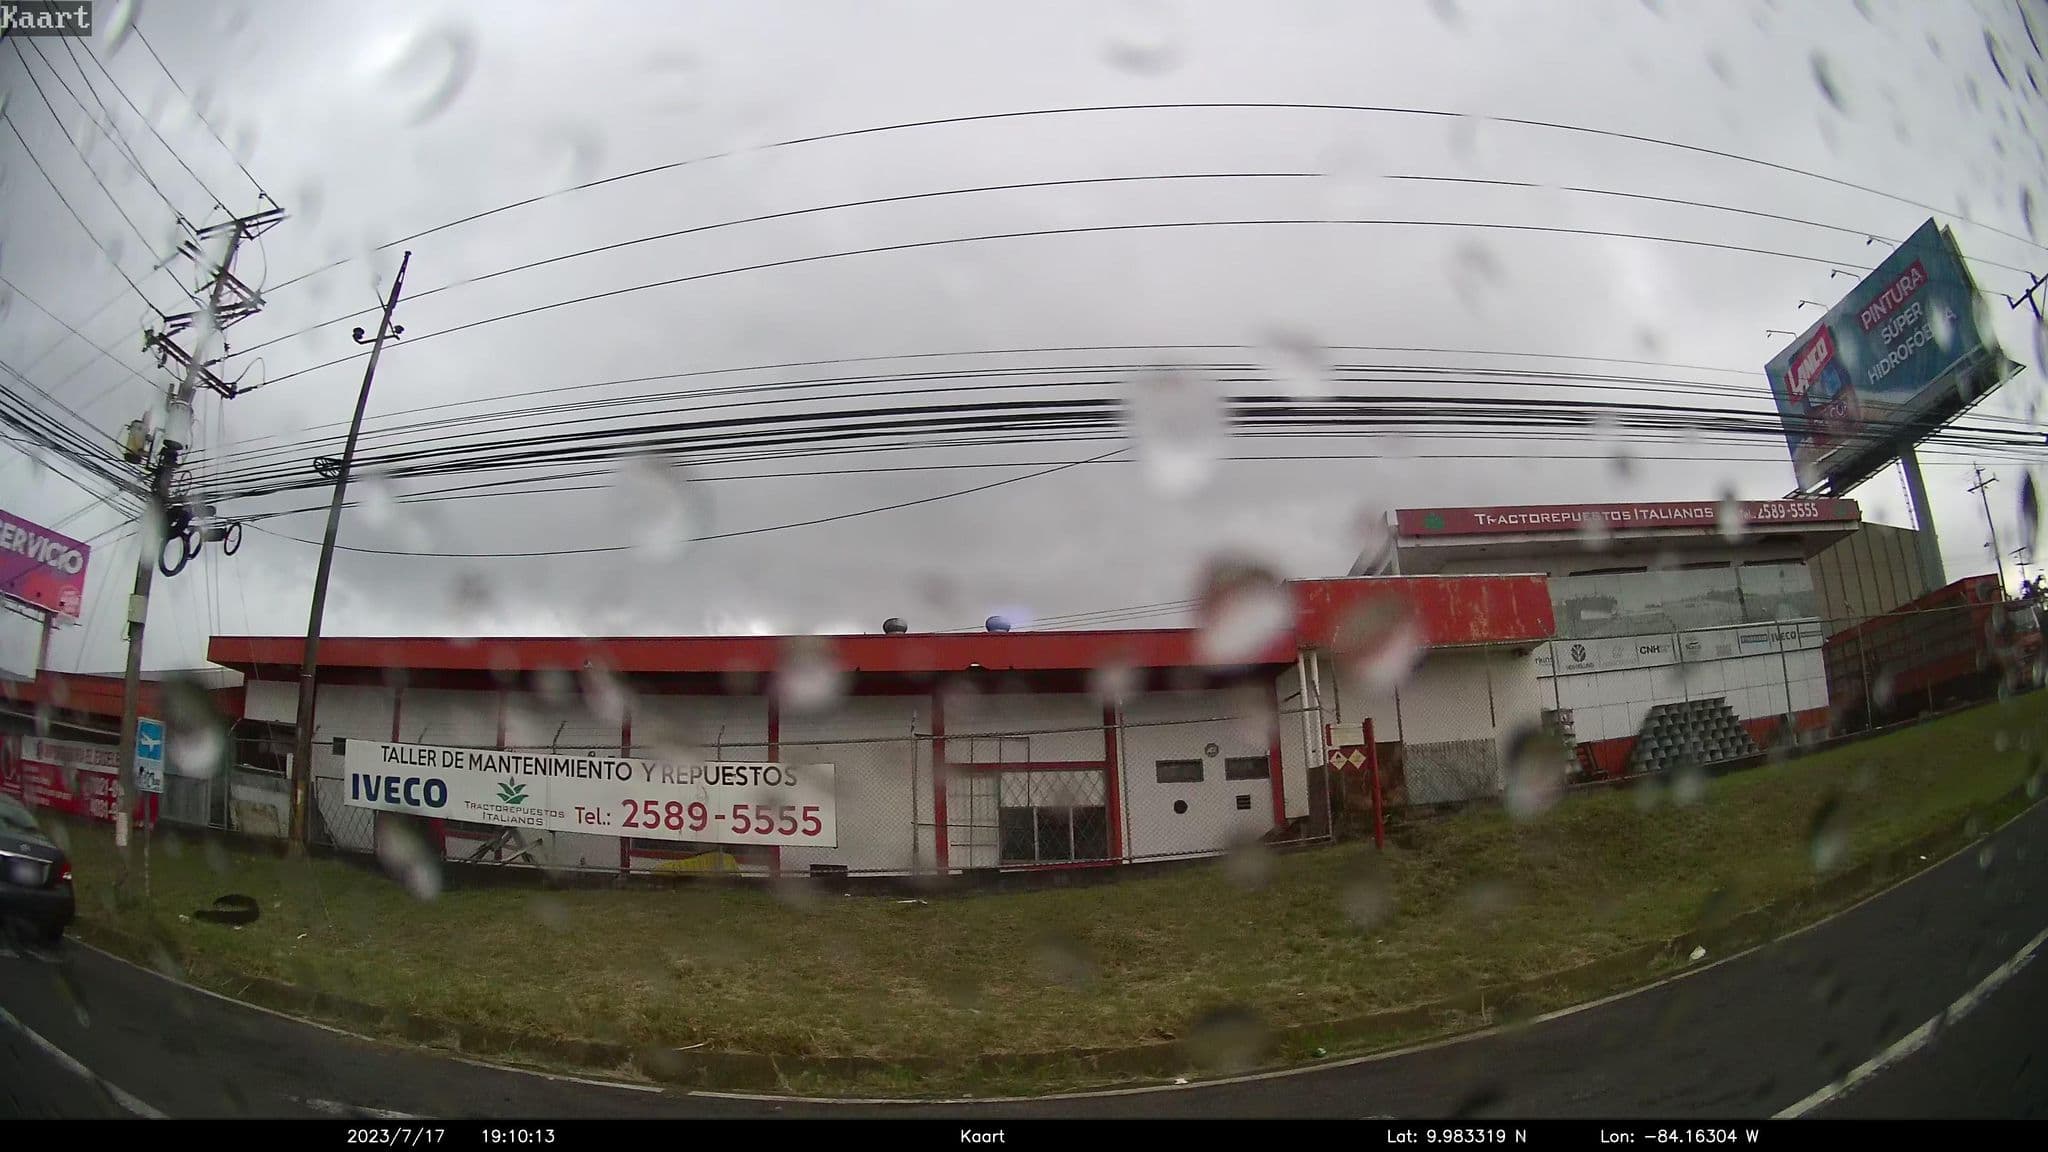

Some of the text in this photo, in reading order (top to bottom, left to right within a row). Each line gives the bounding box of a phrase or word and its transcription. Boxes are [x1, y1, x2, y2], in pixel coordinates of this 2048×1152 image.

[1860, 267, 1923, 330] PINTURA
[1634, 507, 1714, 520] ITALIANOS
[1758, 503, 1818, 519] 2589-5555
[1771, 631, 1796, 642] IVECO
[1639, 645, 1660, 654] CNH
[381, 746, 797, 786] TALLER DE MANTENIMIENTO Y REPUESTOS
[352, 773, 448, 808] IVECO
[464, 800, 565, 819] TRACTOREPUESTOS
[482, 811, 544, 826] ITALIANOS
[575, 799, 822, 837] Tel.: 2589-5555
